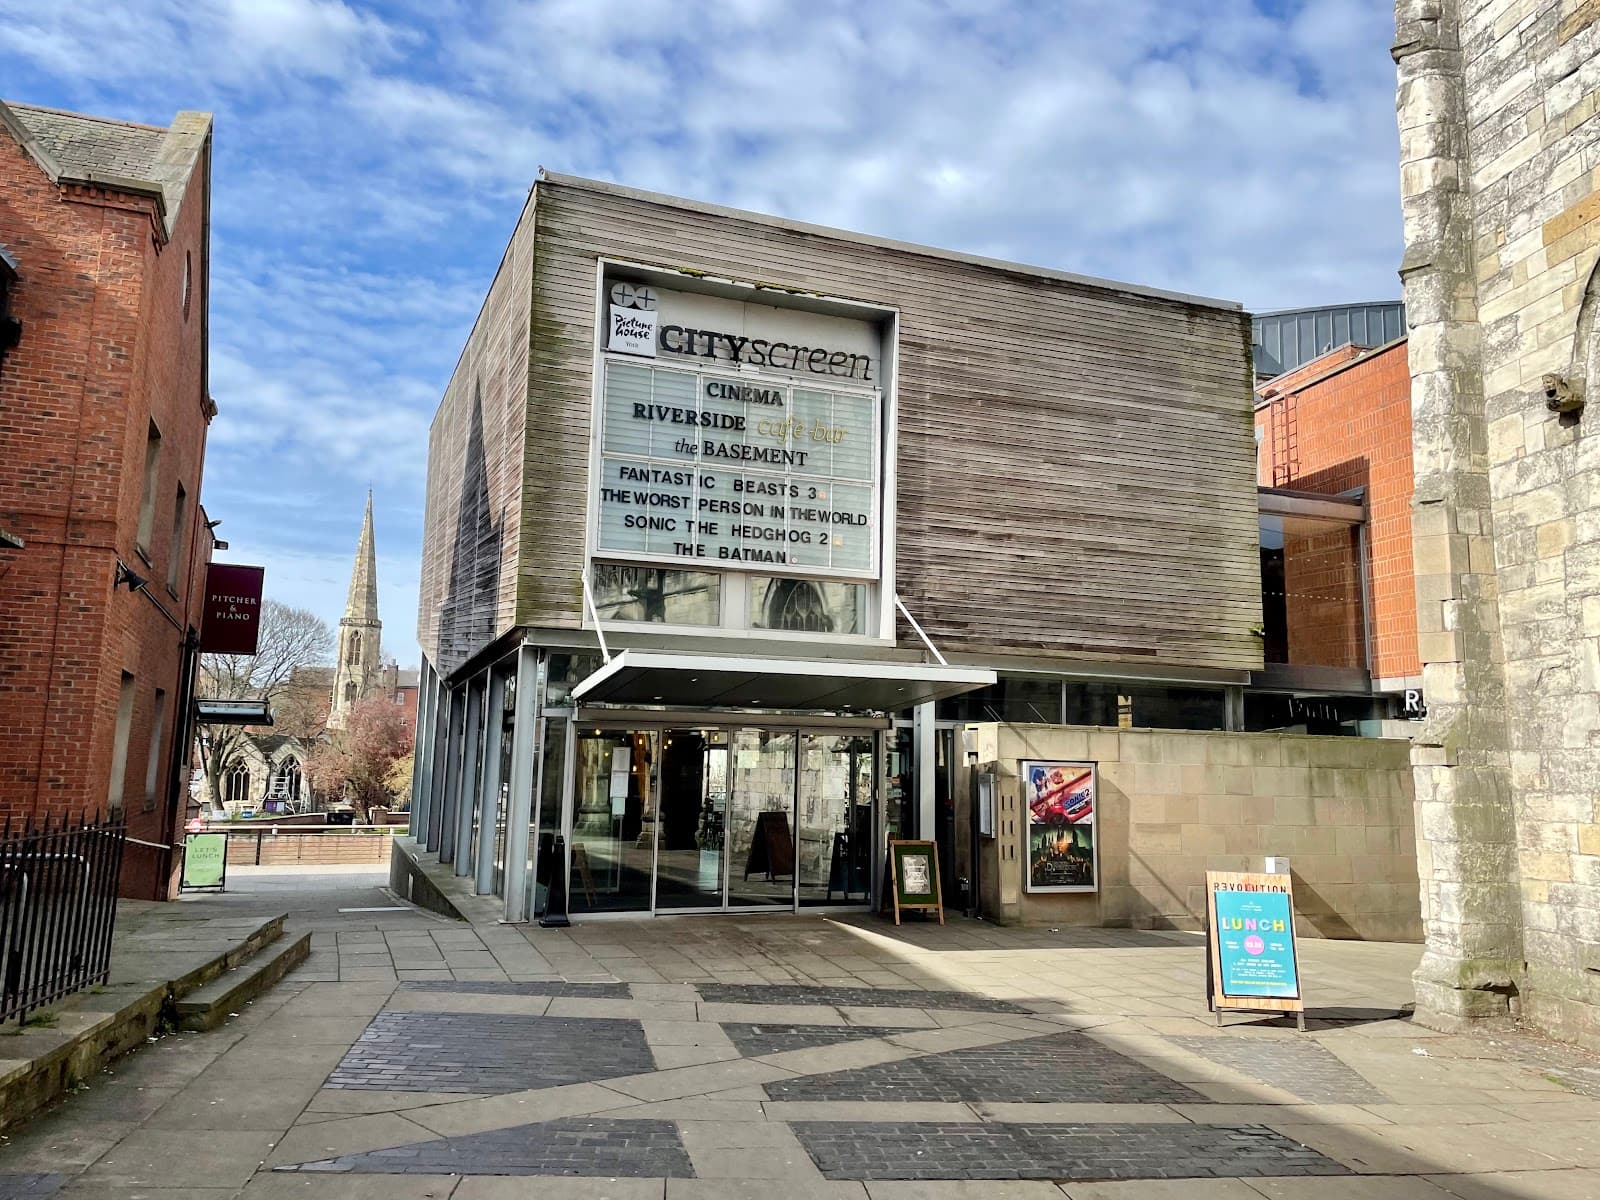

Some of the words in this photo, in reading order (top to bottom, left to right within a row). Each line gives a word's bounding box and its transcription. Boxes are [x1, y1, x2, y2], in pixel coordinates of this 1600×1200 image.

[614, 313, 653, 331] Picture
[615, 323, 650, 340] house
[706, 382, 784, 406] CINEMA
[632, 402, 746, 431] RIVERSIDE
[674, 437, 698, 455] the
[702, 440, 808, 466] BASEMENT
[619, 466, 716, 489] FANTASTIC
[733, 479, 799, 498] BEASTS
[808, 486, 817, 499] 3
[601, 488, 631, 503] THE
[633, 491, 690, 509] WORST
[698, 498, 764, 517] PERSON
[770, 505, 785, 519] IN
[789, 507, 817, 521] THE
[817, 509, 868, 526] WORLD
[624, 514, 677, 531] SONIC
[685, 520, 719, 535] THE
[731, 524, 812, 544] HEDGHOG
[819, 532, 829, 545] 2
[673, 542, 706, 557] THE
[718, 546, 786, 564] BATMAN
[212, 594, 257, 605] PITCHER
[216, 611, 250, 621] PIANO
[1221, 917, 1286, 933] LUNCH
